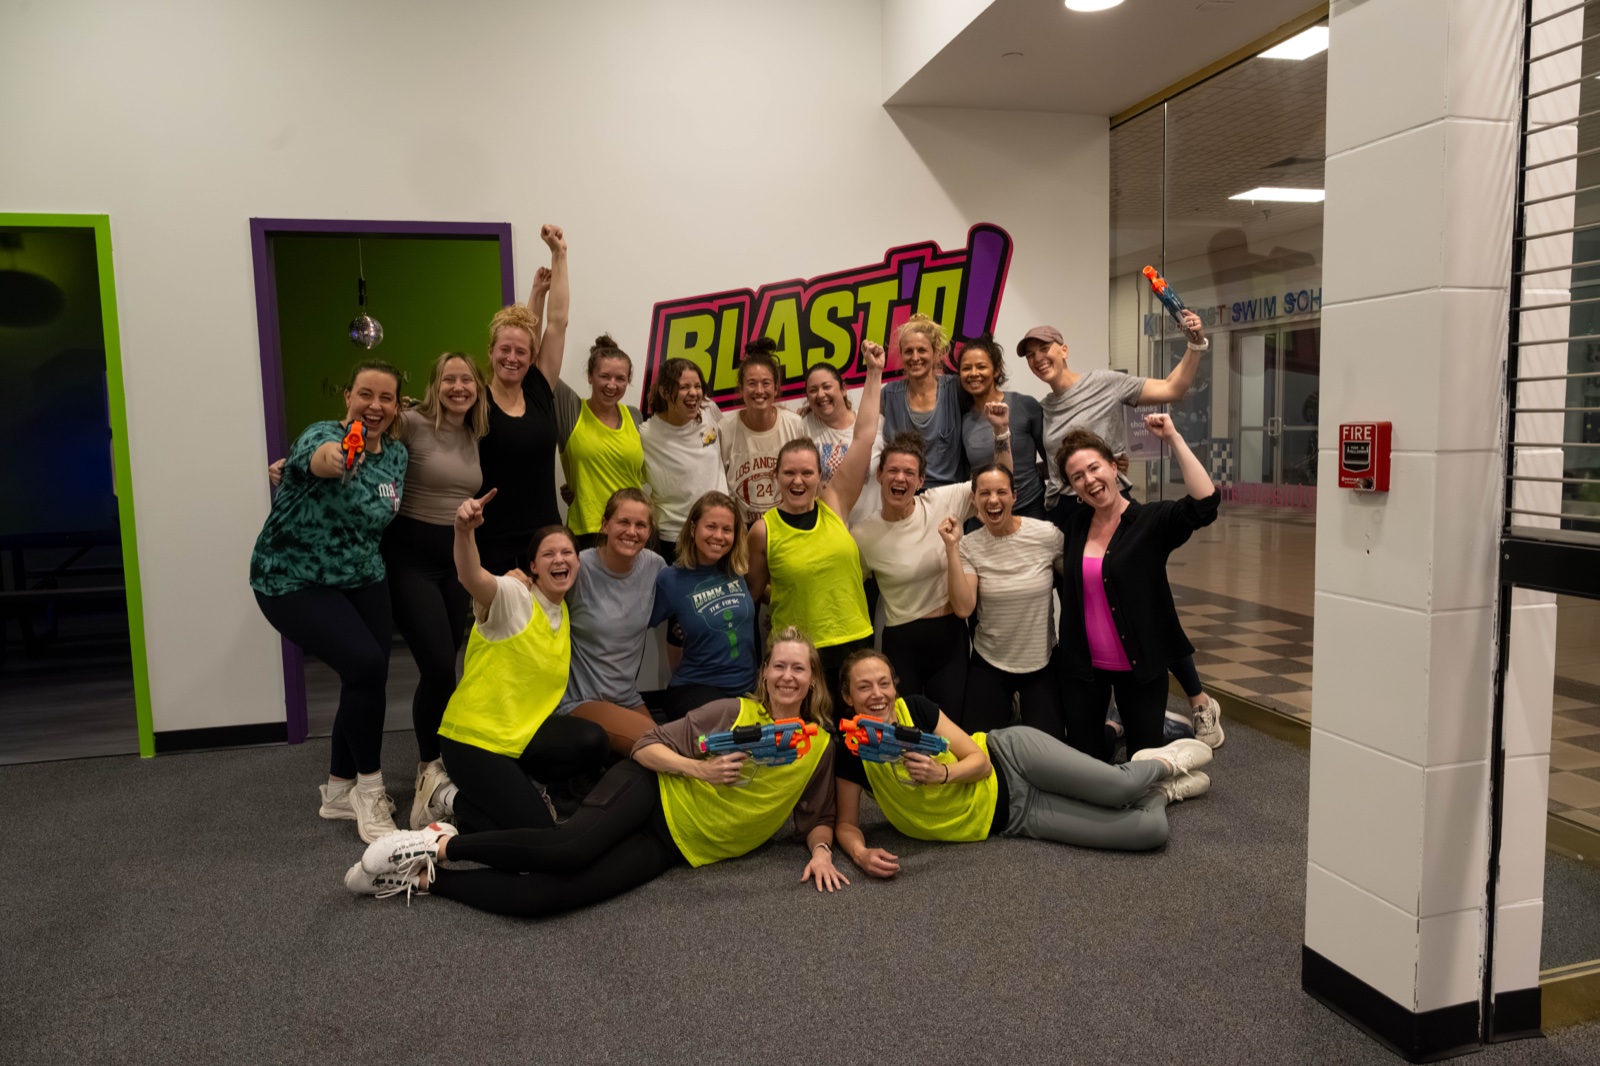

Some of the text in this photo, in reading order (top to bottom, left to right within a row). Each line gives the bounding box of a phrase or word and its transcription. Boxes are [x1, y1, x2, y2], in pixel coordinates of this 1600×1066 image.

[1232, 296, 1277, 322] SWIM
[1343, 426, 1372, 440] FIRE
[735, 461, 750, 481] LOS
[756, 483, 773, 497] 24
[692, 580, 743, 608] DINK AT
